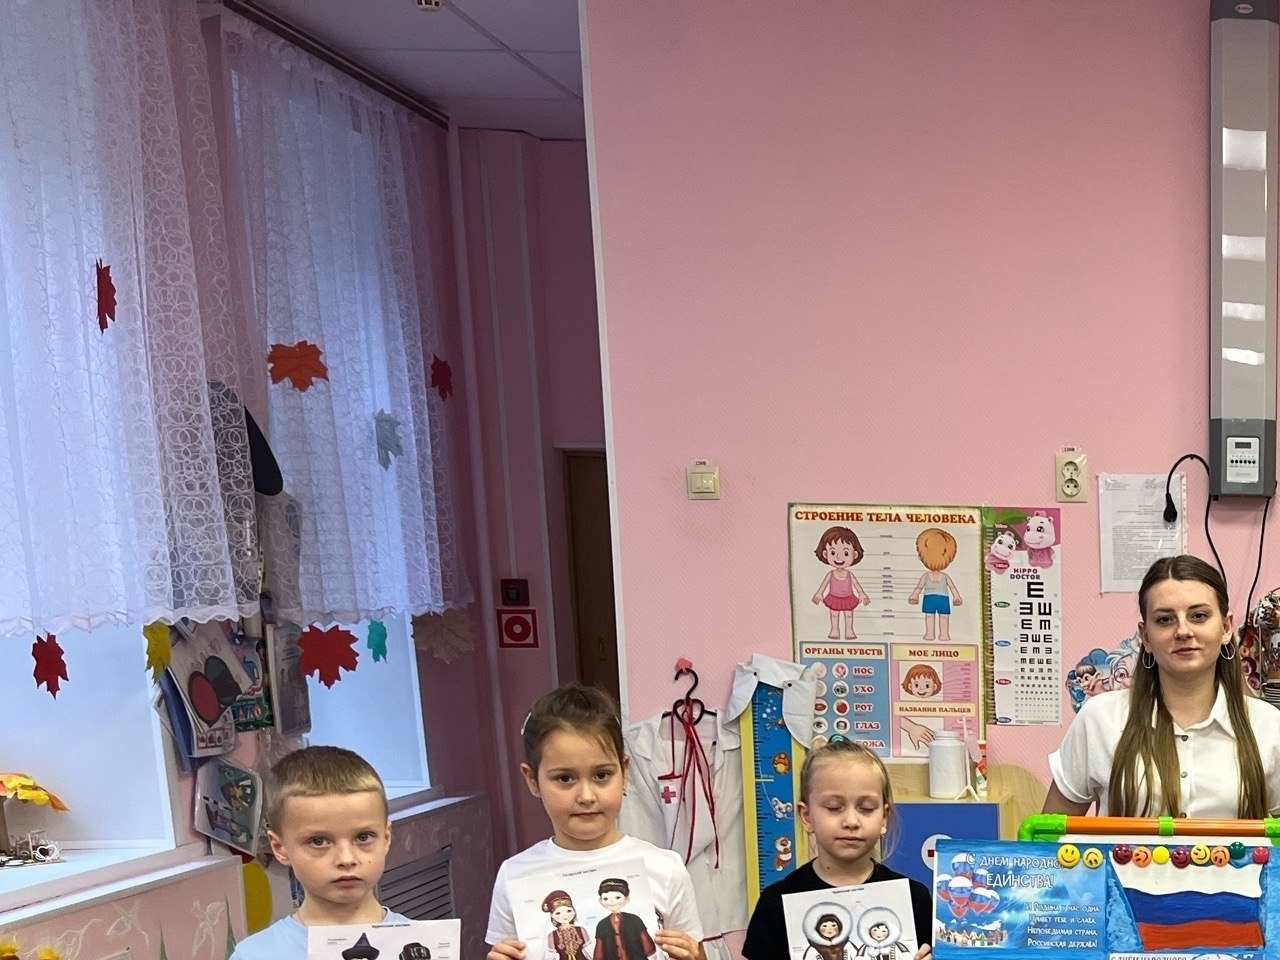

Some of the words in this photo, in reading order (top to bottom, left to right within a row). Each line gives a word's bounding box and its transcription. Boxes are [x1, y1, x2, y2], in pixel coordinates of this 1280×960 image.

[795, 511, 863, 522] СТРОЕНИЕ
[867, 512, 902, 523] ТЕЛА
[906, 512, 976, 524] ЧЕЛОВЕКА
[804, 647, 844, 656] ОРГАНЫ
[847, 648, 883, 656] ЧУВСТВ
[908, 649, 929, 657] МОЕ
[931, 650, 960, 658] ЛИЦО
[853, 685, 874, 693] УХО
[854, 703, 873, 711] РОТ
[854, 722, 880, 730] ГЛАЗ
[980, 855, 1009, 867] ДНЕМ
[1014, 857, 1062, 869] НАРОДНО
[986, 873, 1054, 888] ЕДИНСТВА!
